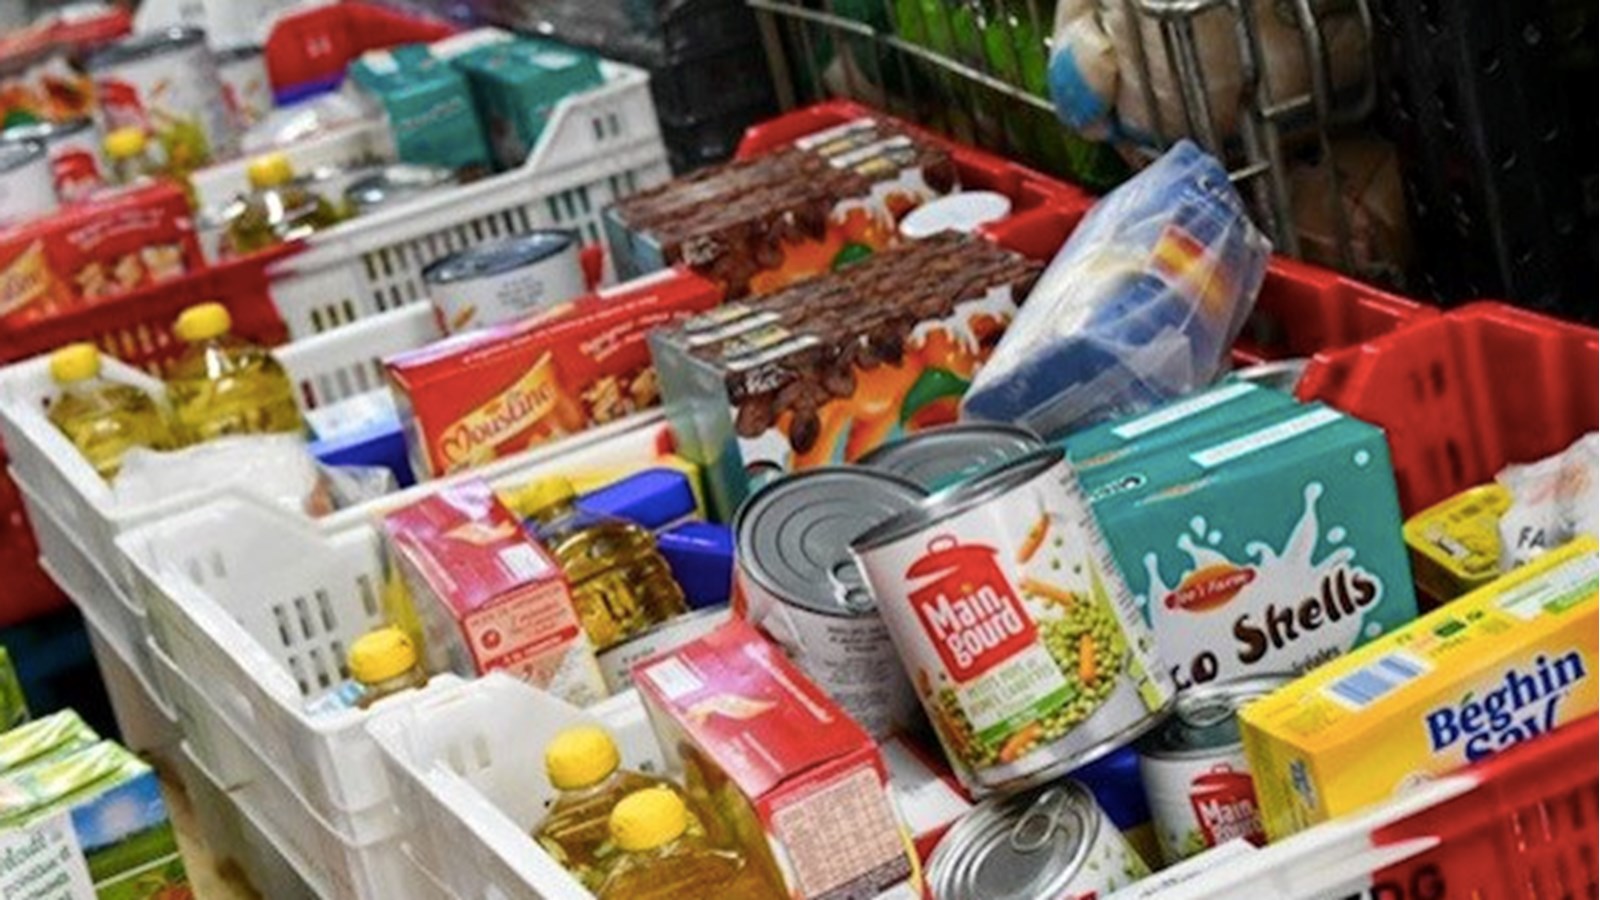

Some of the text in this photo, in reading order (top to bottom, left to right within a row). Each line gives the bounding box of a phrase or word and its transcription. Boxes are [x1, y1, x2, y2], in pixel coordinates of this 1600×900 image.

[921, 585, 1000, 640] Main
[946, 596, 1025, 669] gourd
[1233, 569, 1376, 664] Shells
[1426, 652, 1586, 751] Béghin
[1198, 799, 1253, 829] Main
